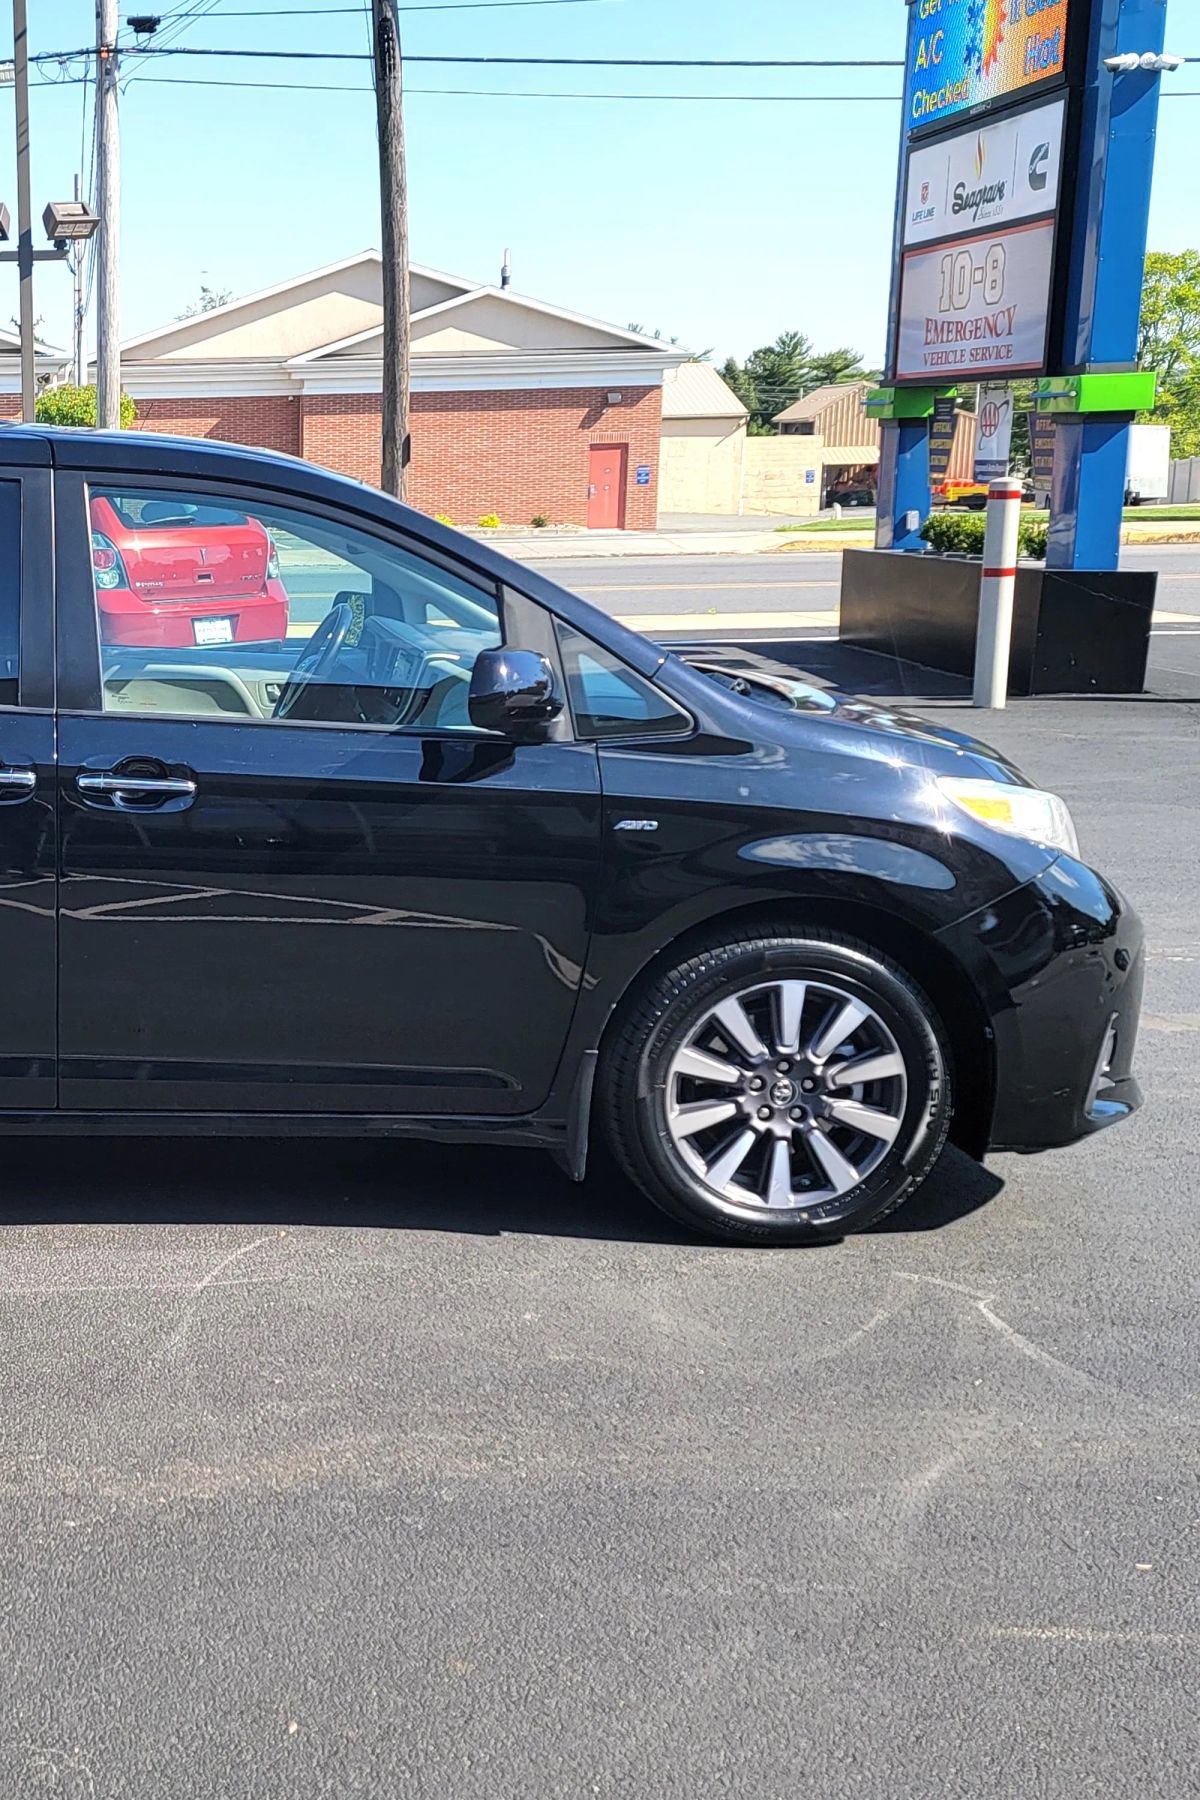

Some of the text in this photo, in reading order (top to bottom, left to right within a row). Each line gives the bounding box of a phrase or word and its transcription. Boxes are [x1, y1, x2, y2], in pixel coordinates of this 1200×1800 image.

[915, 28, 944, 73] A/C
[1024, 26, 1060, 76] Hot
[912, 67, 971, 119] Checked
[952, 180, 1006, 223] Seagrave
[939, 242, 1007, 313] 10-8
[924, 303, 1018, 347] EMERGENCY
[923, 343, 1013, 367] VEHICLE SERVICE
